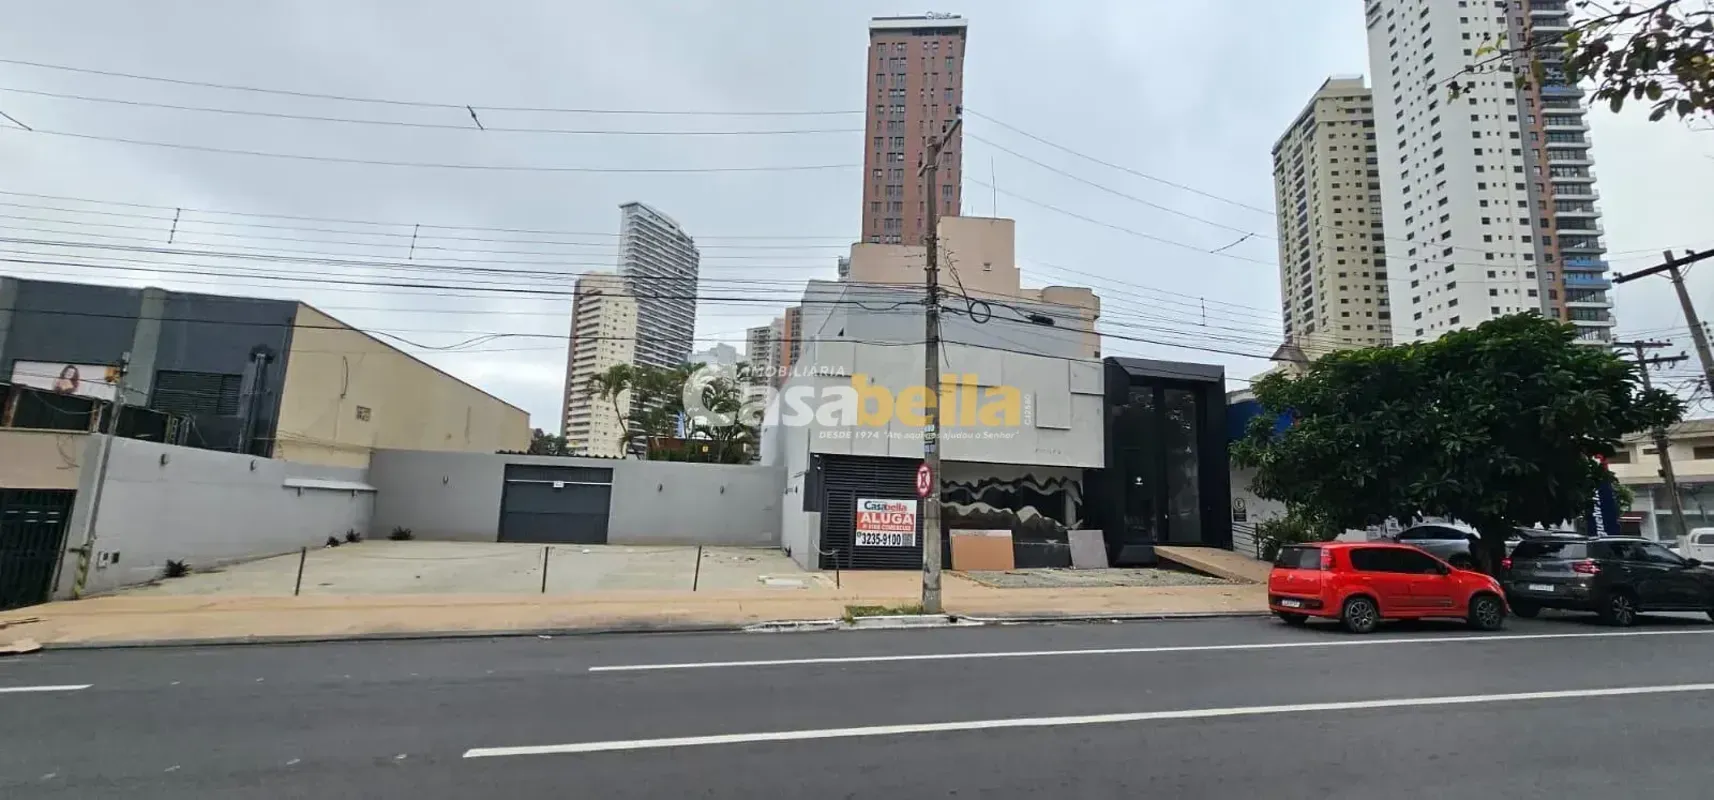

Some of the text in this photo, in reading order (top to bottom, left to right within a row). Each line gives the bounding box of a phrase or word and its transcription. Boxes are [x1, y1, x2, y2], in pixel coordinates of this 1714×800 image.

[864, 501, 908, 512] Casabella
[861, 512, 913, 525] ALUGA
[862, 533, 901, 545] 3235-9100
